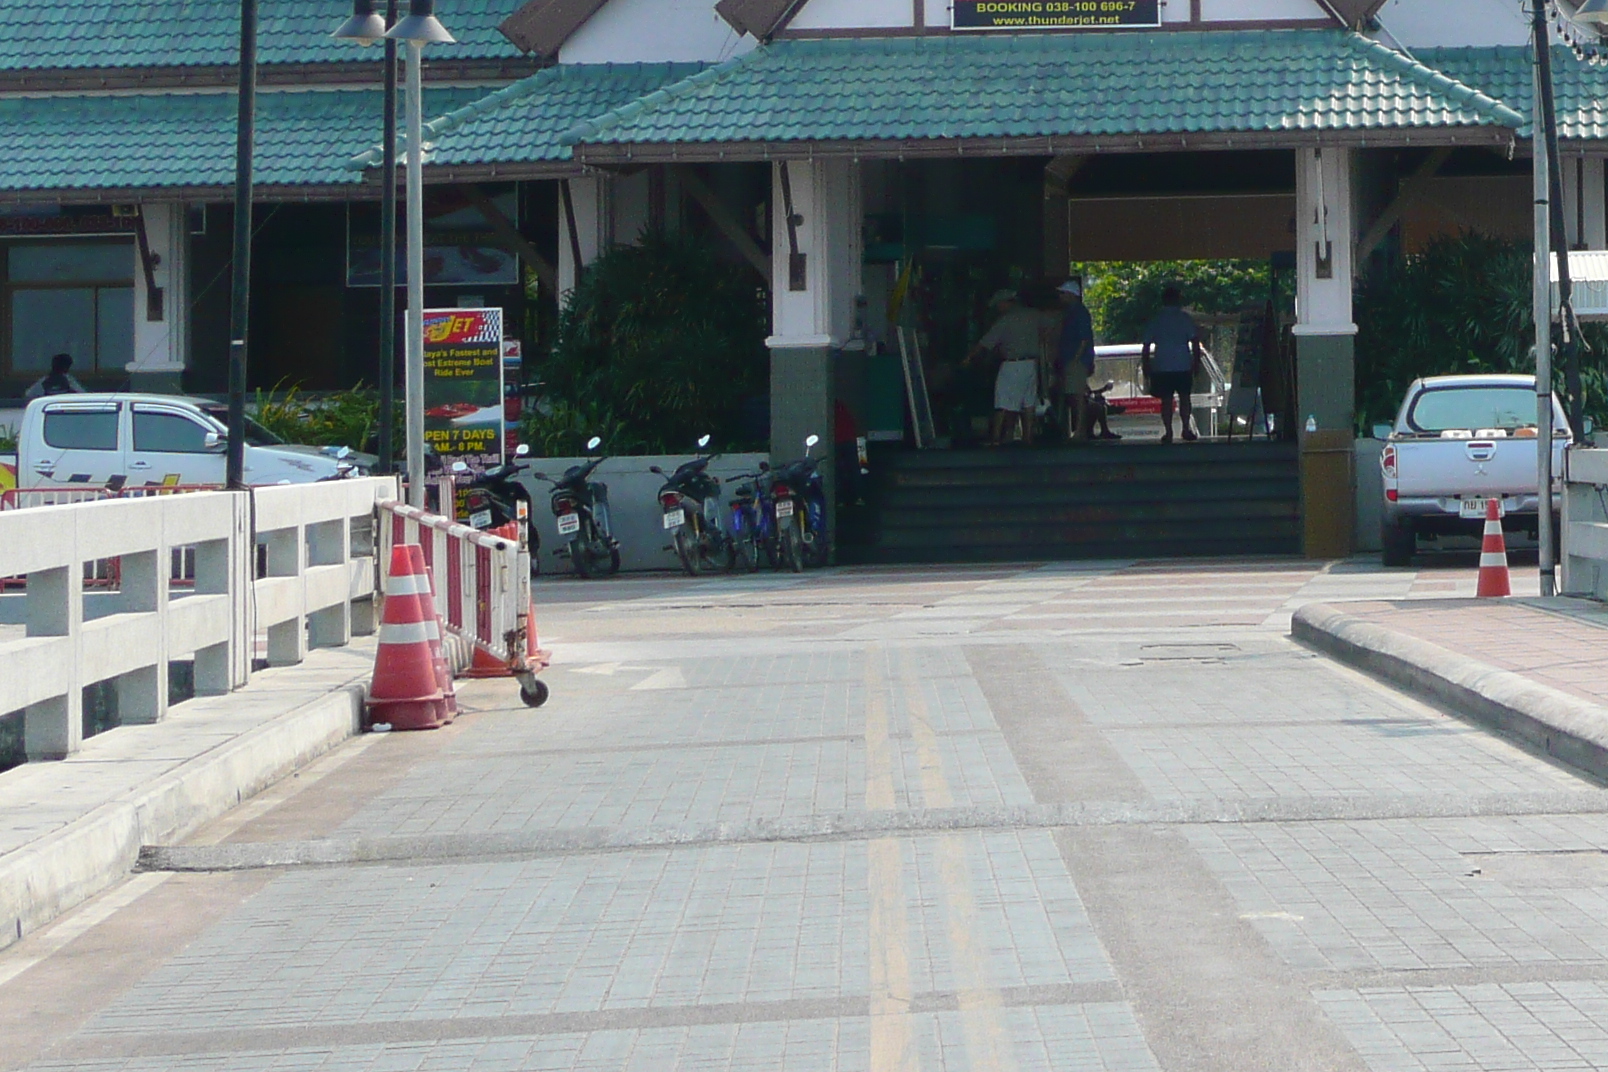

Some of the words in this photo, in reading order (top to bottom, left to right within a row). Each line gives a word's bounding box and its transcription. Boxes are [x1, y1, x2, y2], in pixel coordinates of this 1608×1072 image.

[976, 2, 1042, 13] BOOKING
[1046, 2, 1097, 12] 038-100
[1100, 1, 1136, 12] 696-7
[993, 15, 1120, 26] www.thunderjet.net
[430, 315, 475, 342] JET
[450, 348, 480, 358] Fastest
[482, 348, 498, 356] and
[437, 359, 472, 367] Extreme
[434, 368, 453, 377] Ride
[455, 368, 474, 376] Ever
[423, 430, 449, 441] PEN
[453, 430, 460, 440] 7
[462, 429, 495, 440] DAYS
